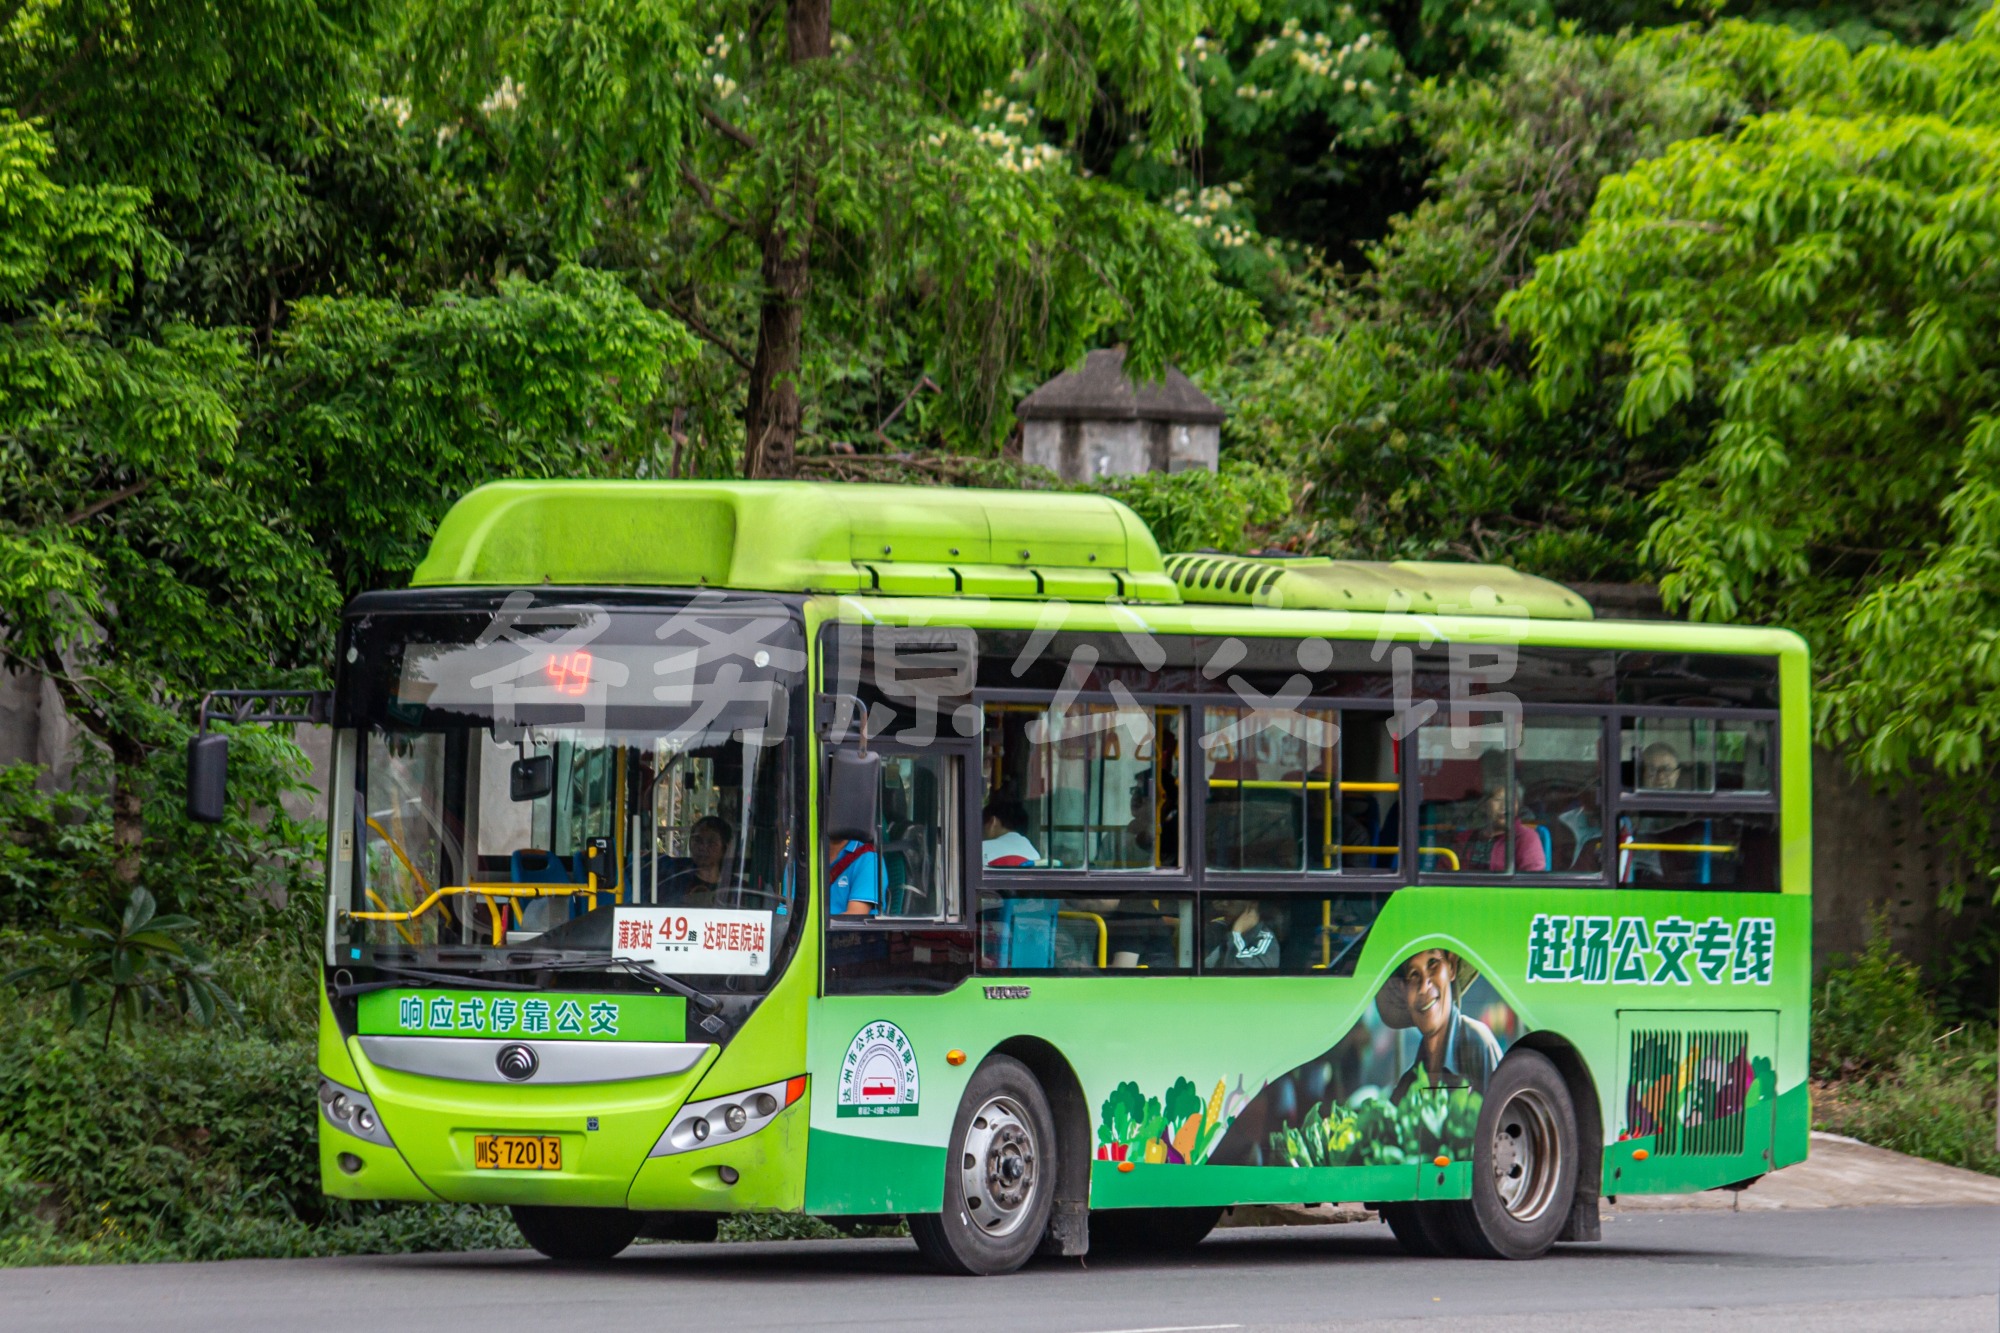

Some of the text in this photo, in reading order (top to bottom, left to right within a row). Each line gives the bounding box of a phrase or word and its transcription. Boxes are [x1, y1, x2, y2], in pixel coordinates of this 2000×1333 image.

[548, 652, 592, 696] 49
[617, 920, 653, 950] 蒲家站
[702, 921, 766, 953] 达职医院站
[1526, 914, 1776, 985] 赶场公交专线
[400, 996, 619, 1035] 响应式停靠公交
[842, 1023, 915, 1103] 达州市公共交通有限公司
